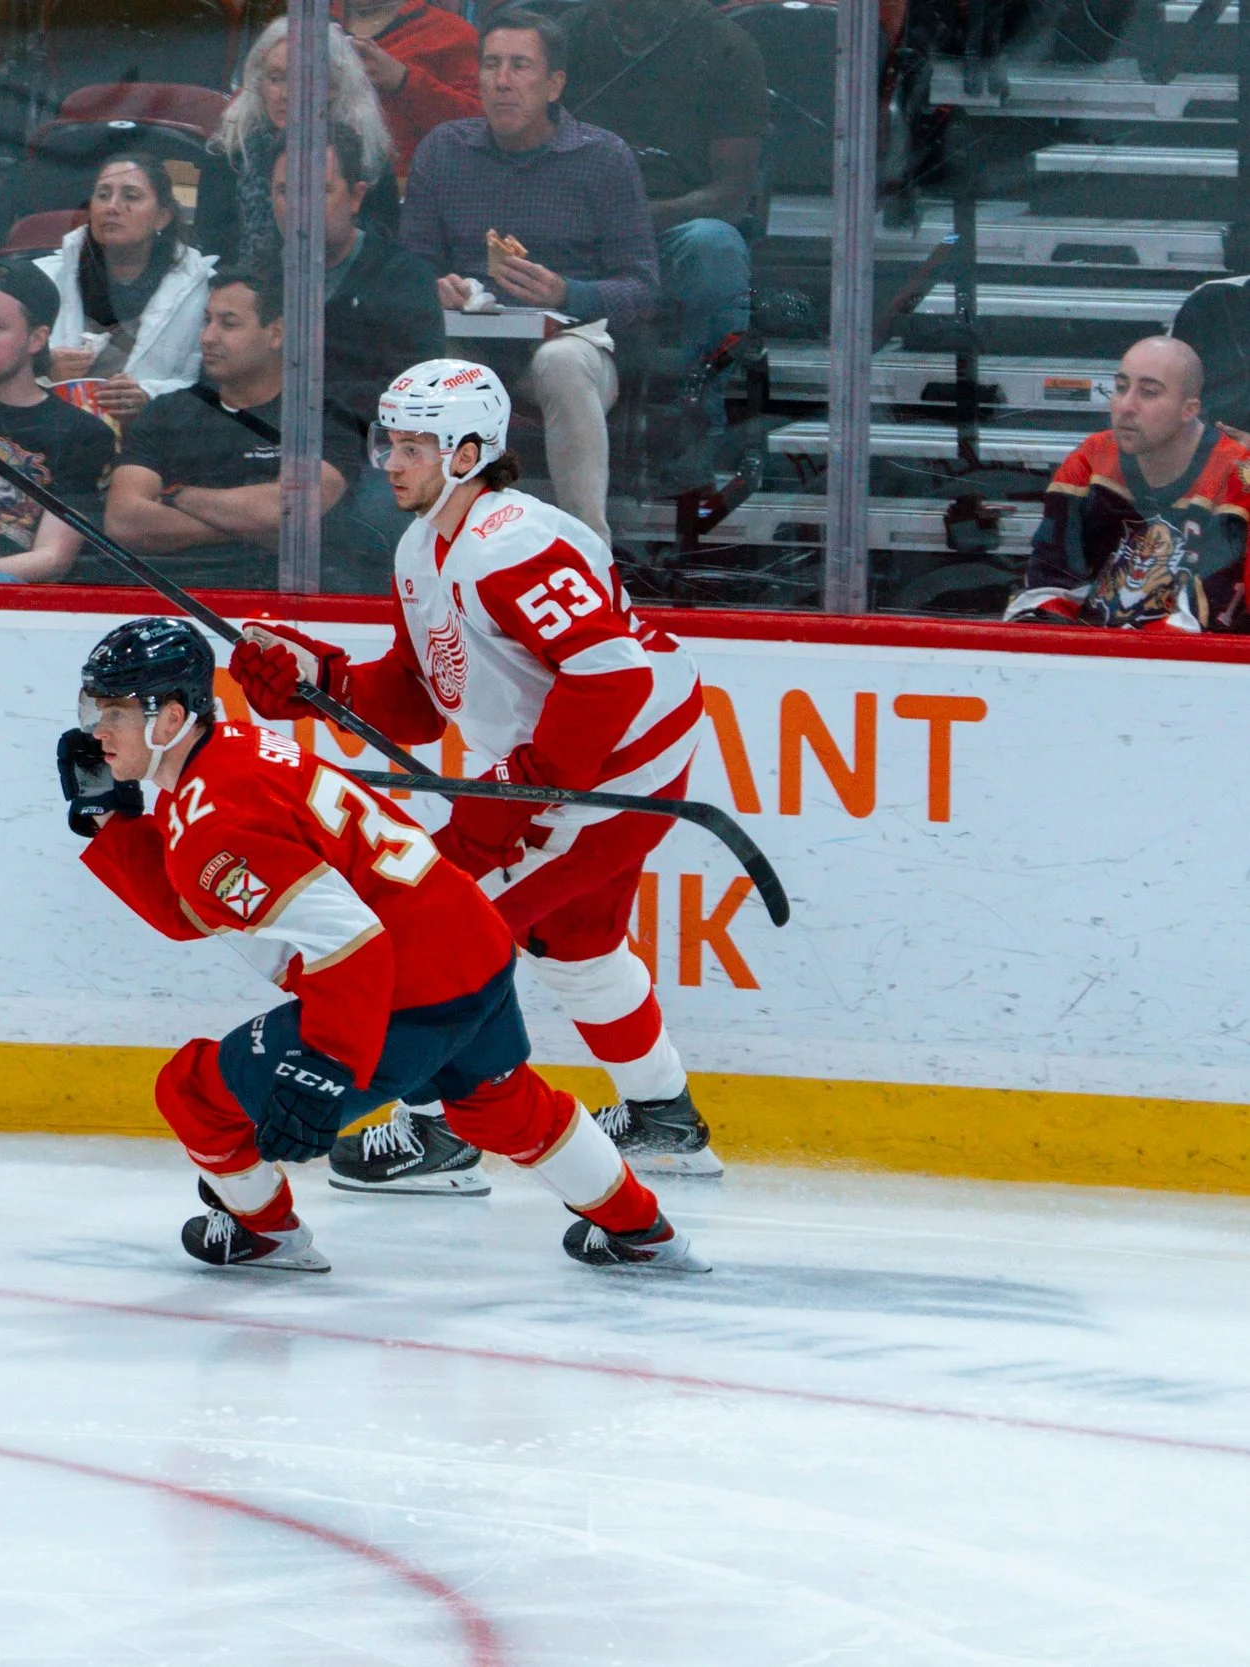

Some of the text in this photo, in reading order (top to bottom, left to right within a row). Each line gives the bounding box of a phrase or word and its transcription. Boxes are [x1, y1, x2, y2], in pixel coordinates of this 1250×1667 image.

[442, 367, 484, 390] meijer
[515, 566, 603, 641] 53
[251, 1013, 267, 1055] CM
[275, 1062, 346, 1097] CCM
[386, 1156, 425, 1177] BAUER
